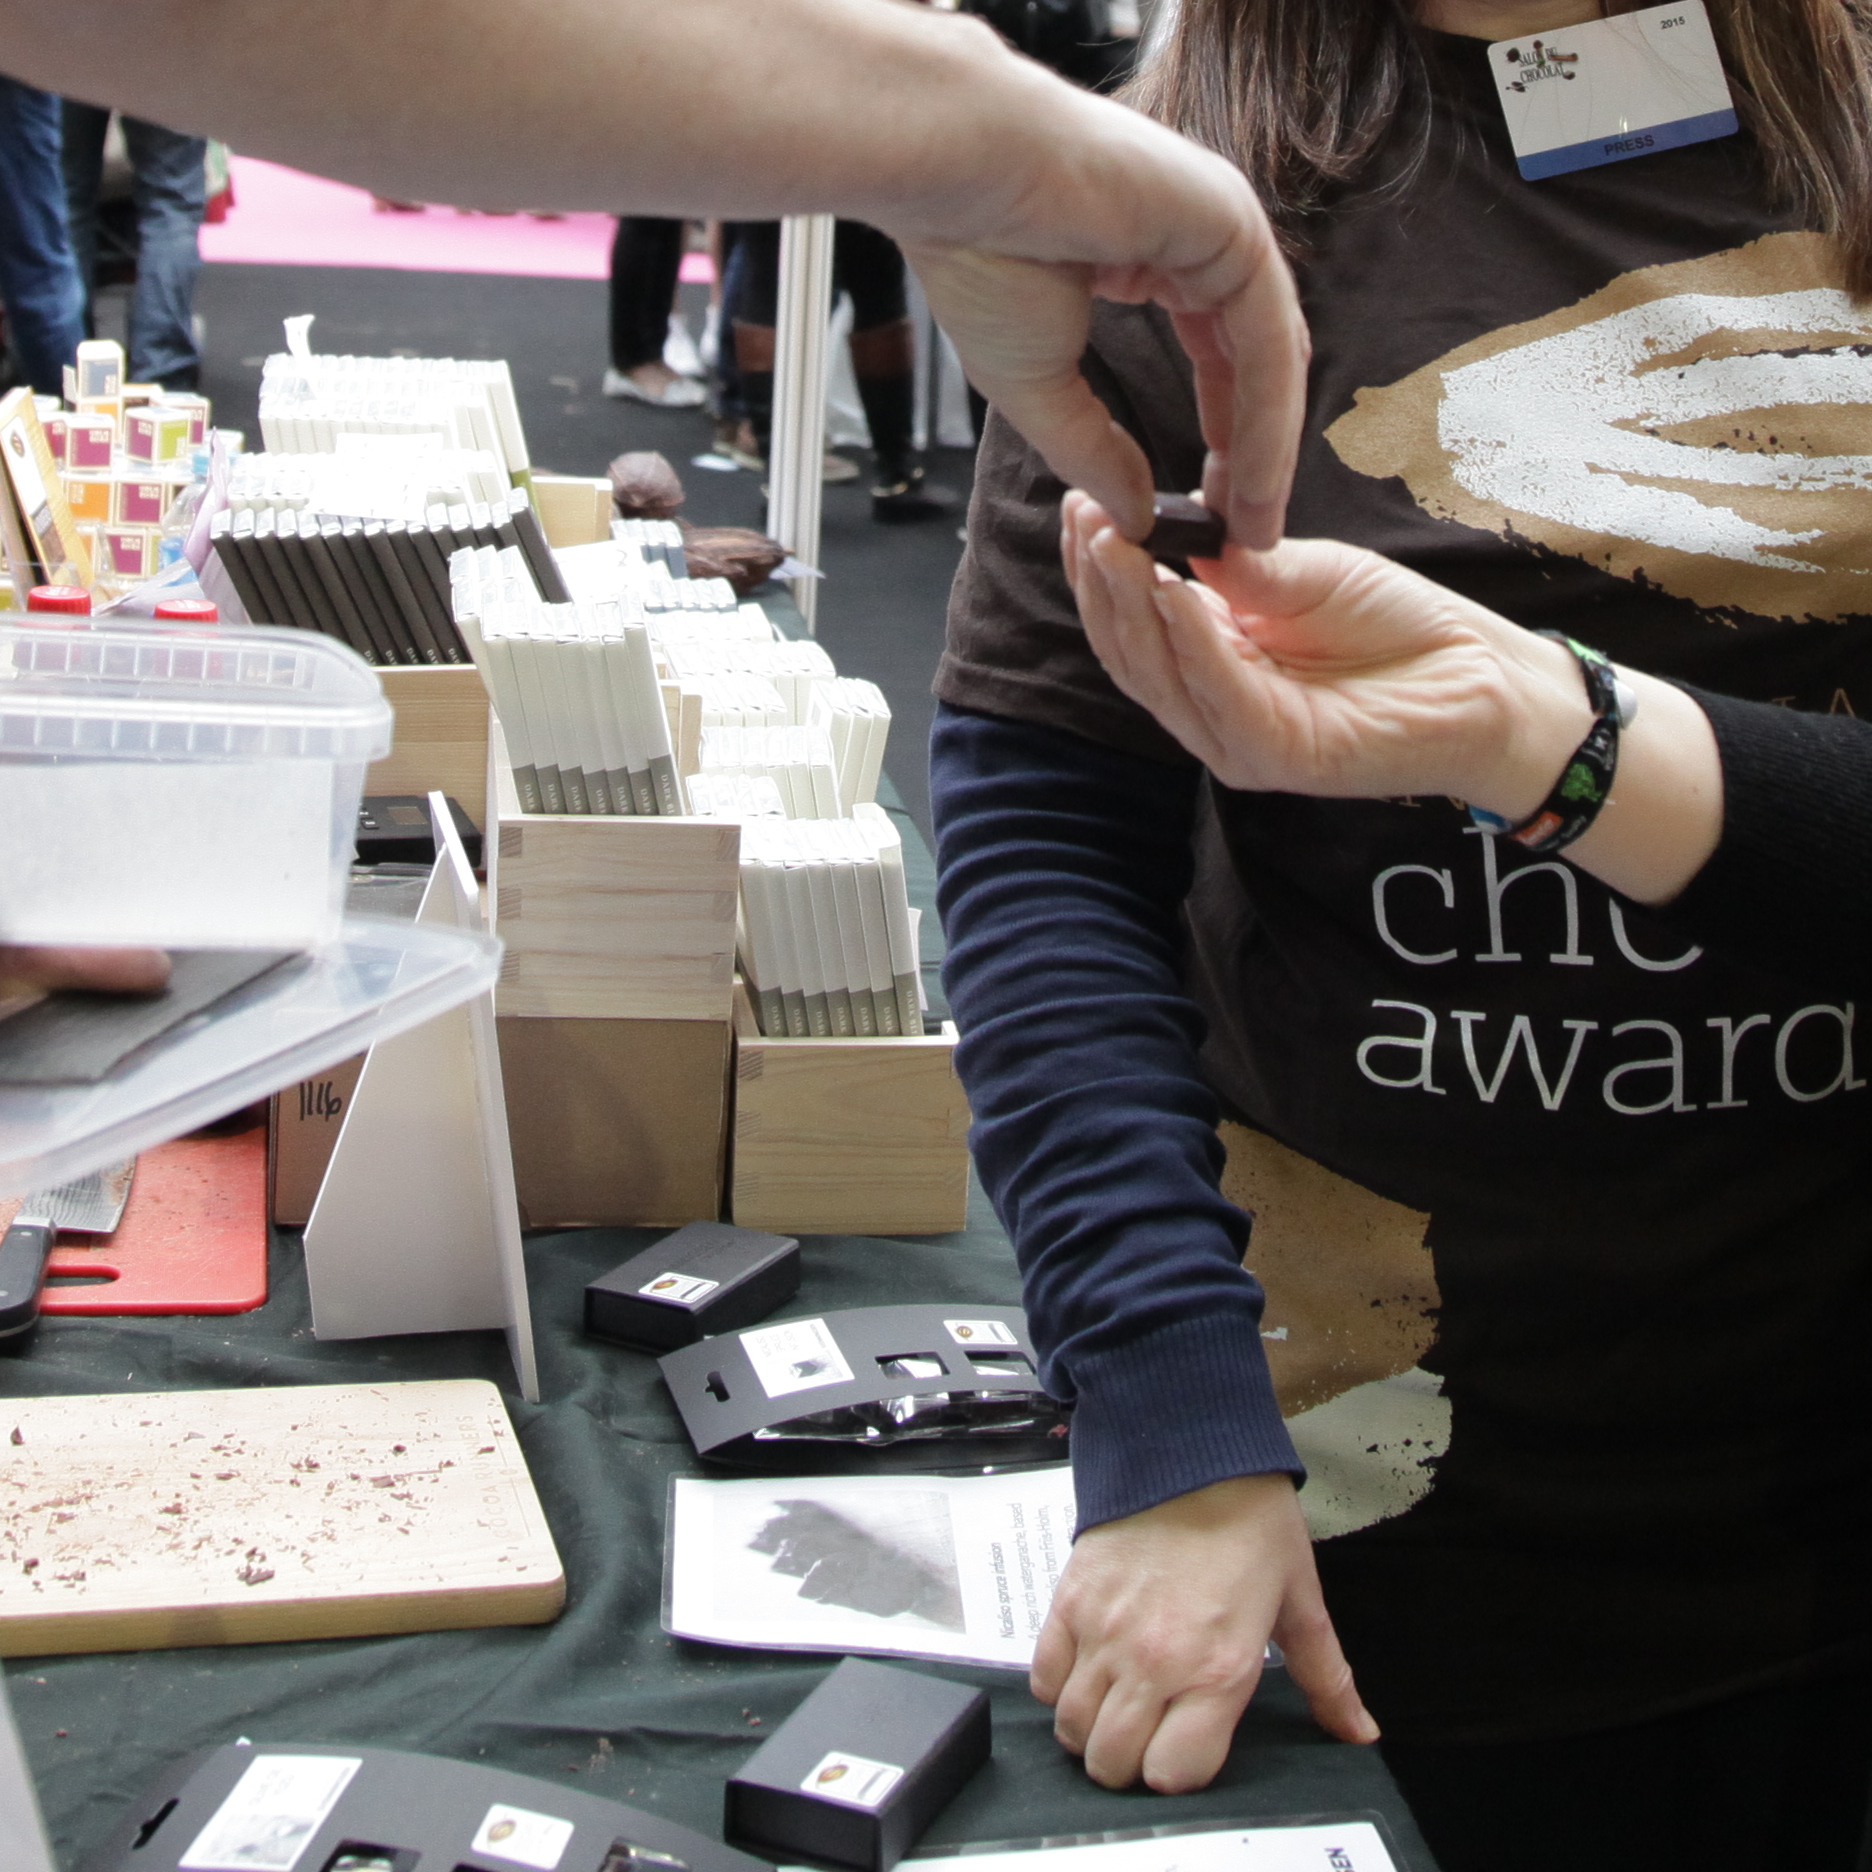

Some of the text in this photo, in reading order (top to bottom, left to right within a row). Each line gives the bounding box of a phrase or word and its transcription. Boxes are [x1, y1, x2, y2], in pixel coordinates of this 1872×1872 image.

[1659, 15, 1686, 30] 2015
[1519, 61, 1565, 84] CHOCOLAT
[1603, 134, 1656, 157] PRESS
[906, 989, 916, 1018] DARK
